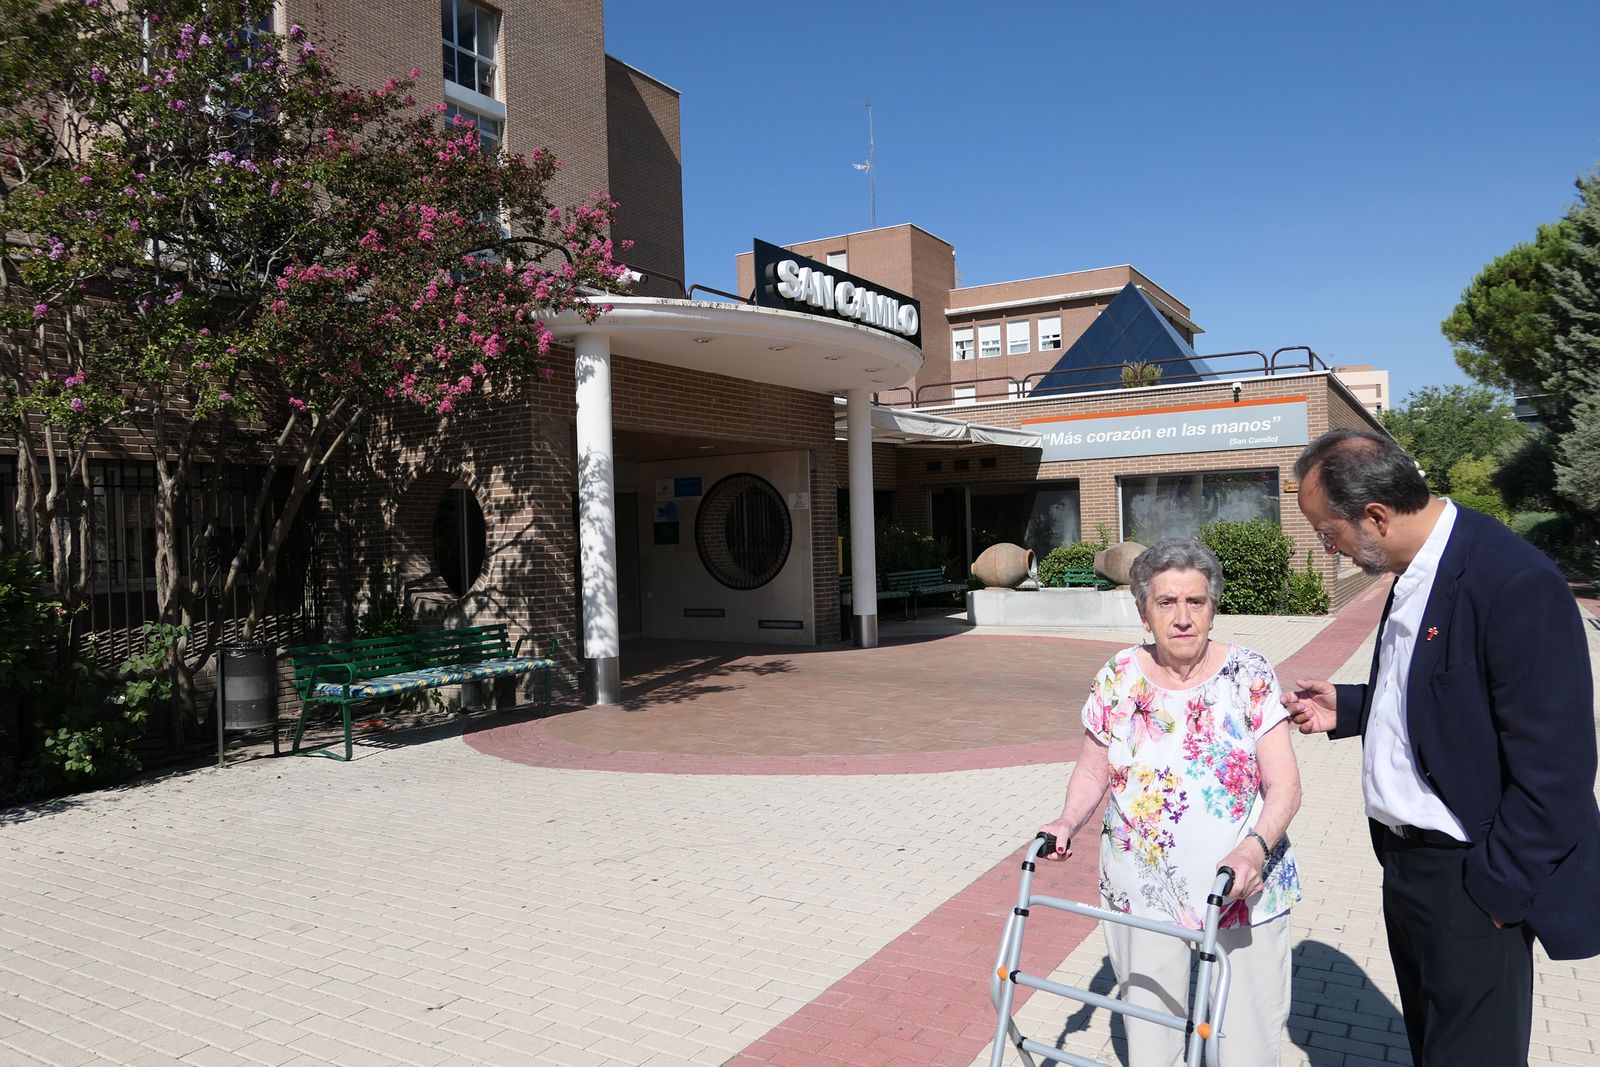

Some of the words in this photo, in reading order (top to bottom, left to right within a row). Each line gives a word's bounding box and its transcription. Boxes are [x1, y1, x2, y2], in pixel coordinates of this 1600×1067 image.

[777, 259, 835, 311] SAN
[834, 281, 919, 337] CAMILO
[1086, 426, 1151, 443] corazón
[1156, 426, 1177, 438] en
[1182, 423, 1207, 436] las
[1229, 437, 1247, 446] (San
